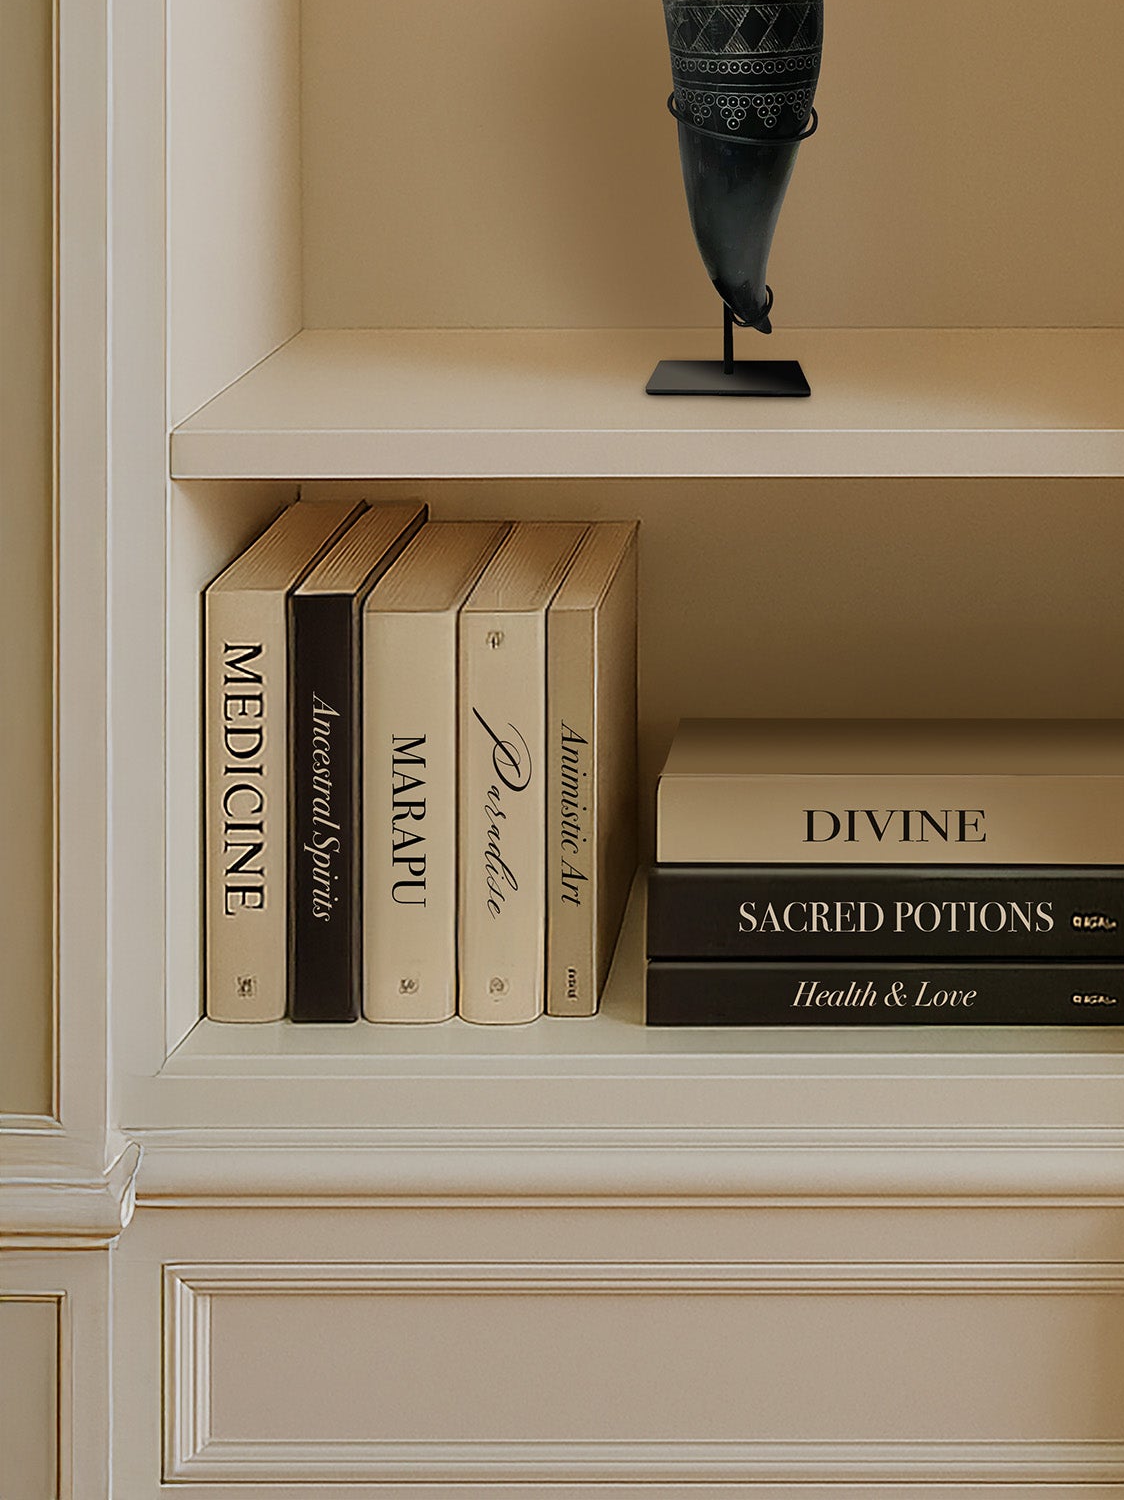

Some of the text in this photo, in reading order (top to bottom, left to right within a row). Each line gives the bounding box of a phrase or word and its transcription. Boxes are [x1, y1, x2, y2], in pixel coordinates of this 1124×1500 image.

[222, 642, 265, 917] MEDICINE
[304, 691, 341, 922] Ancestral Spirits
[391, 733, 427, 908] MARAPU
[472, 707, 532, 920] Paradise
[560, 719, 589, 907] Animistic Art
[802, 809, 986, 843] DIVINE
[738, 901, 885, 934] SACRED
[893, 901, 1055, 933] POTIONS
[789, 981, 977, 1007] Health & Love
